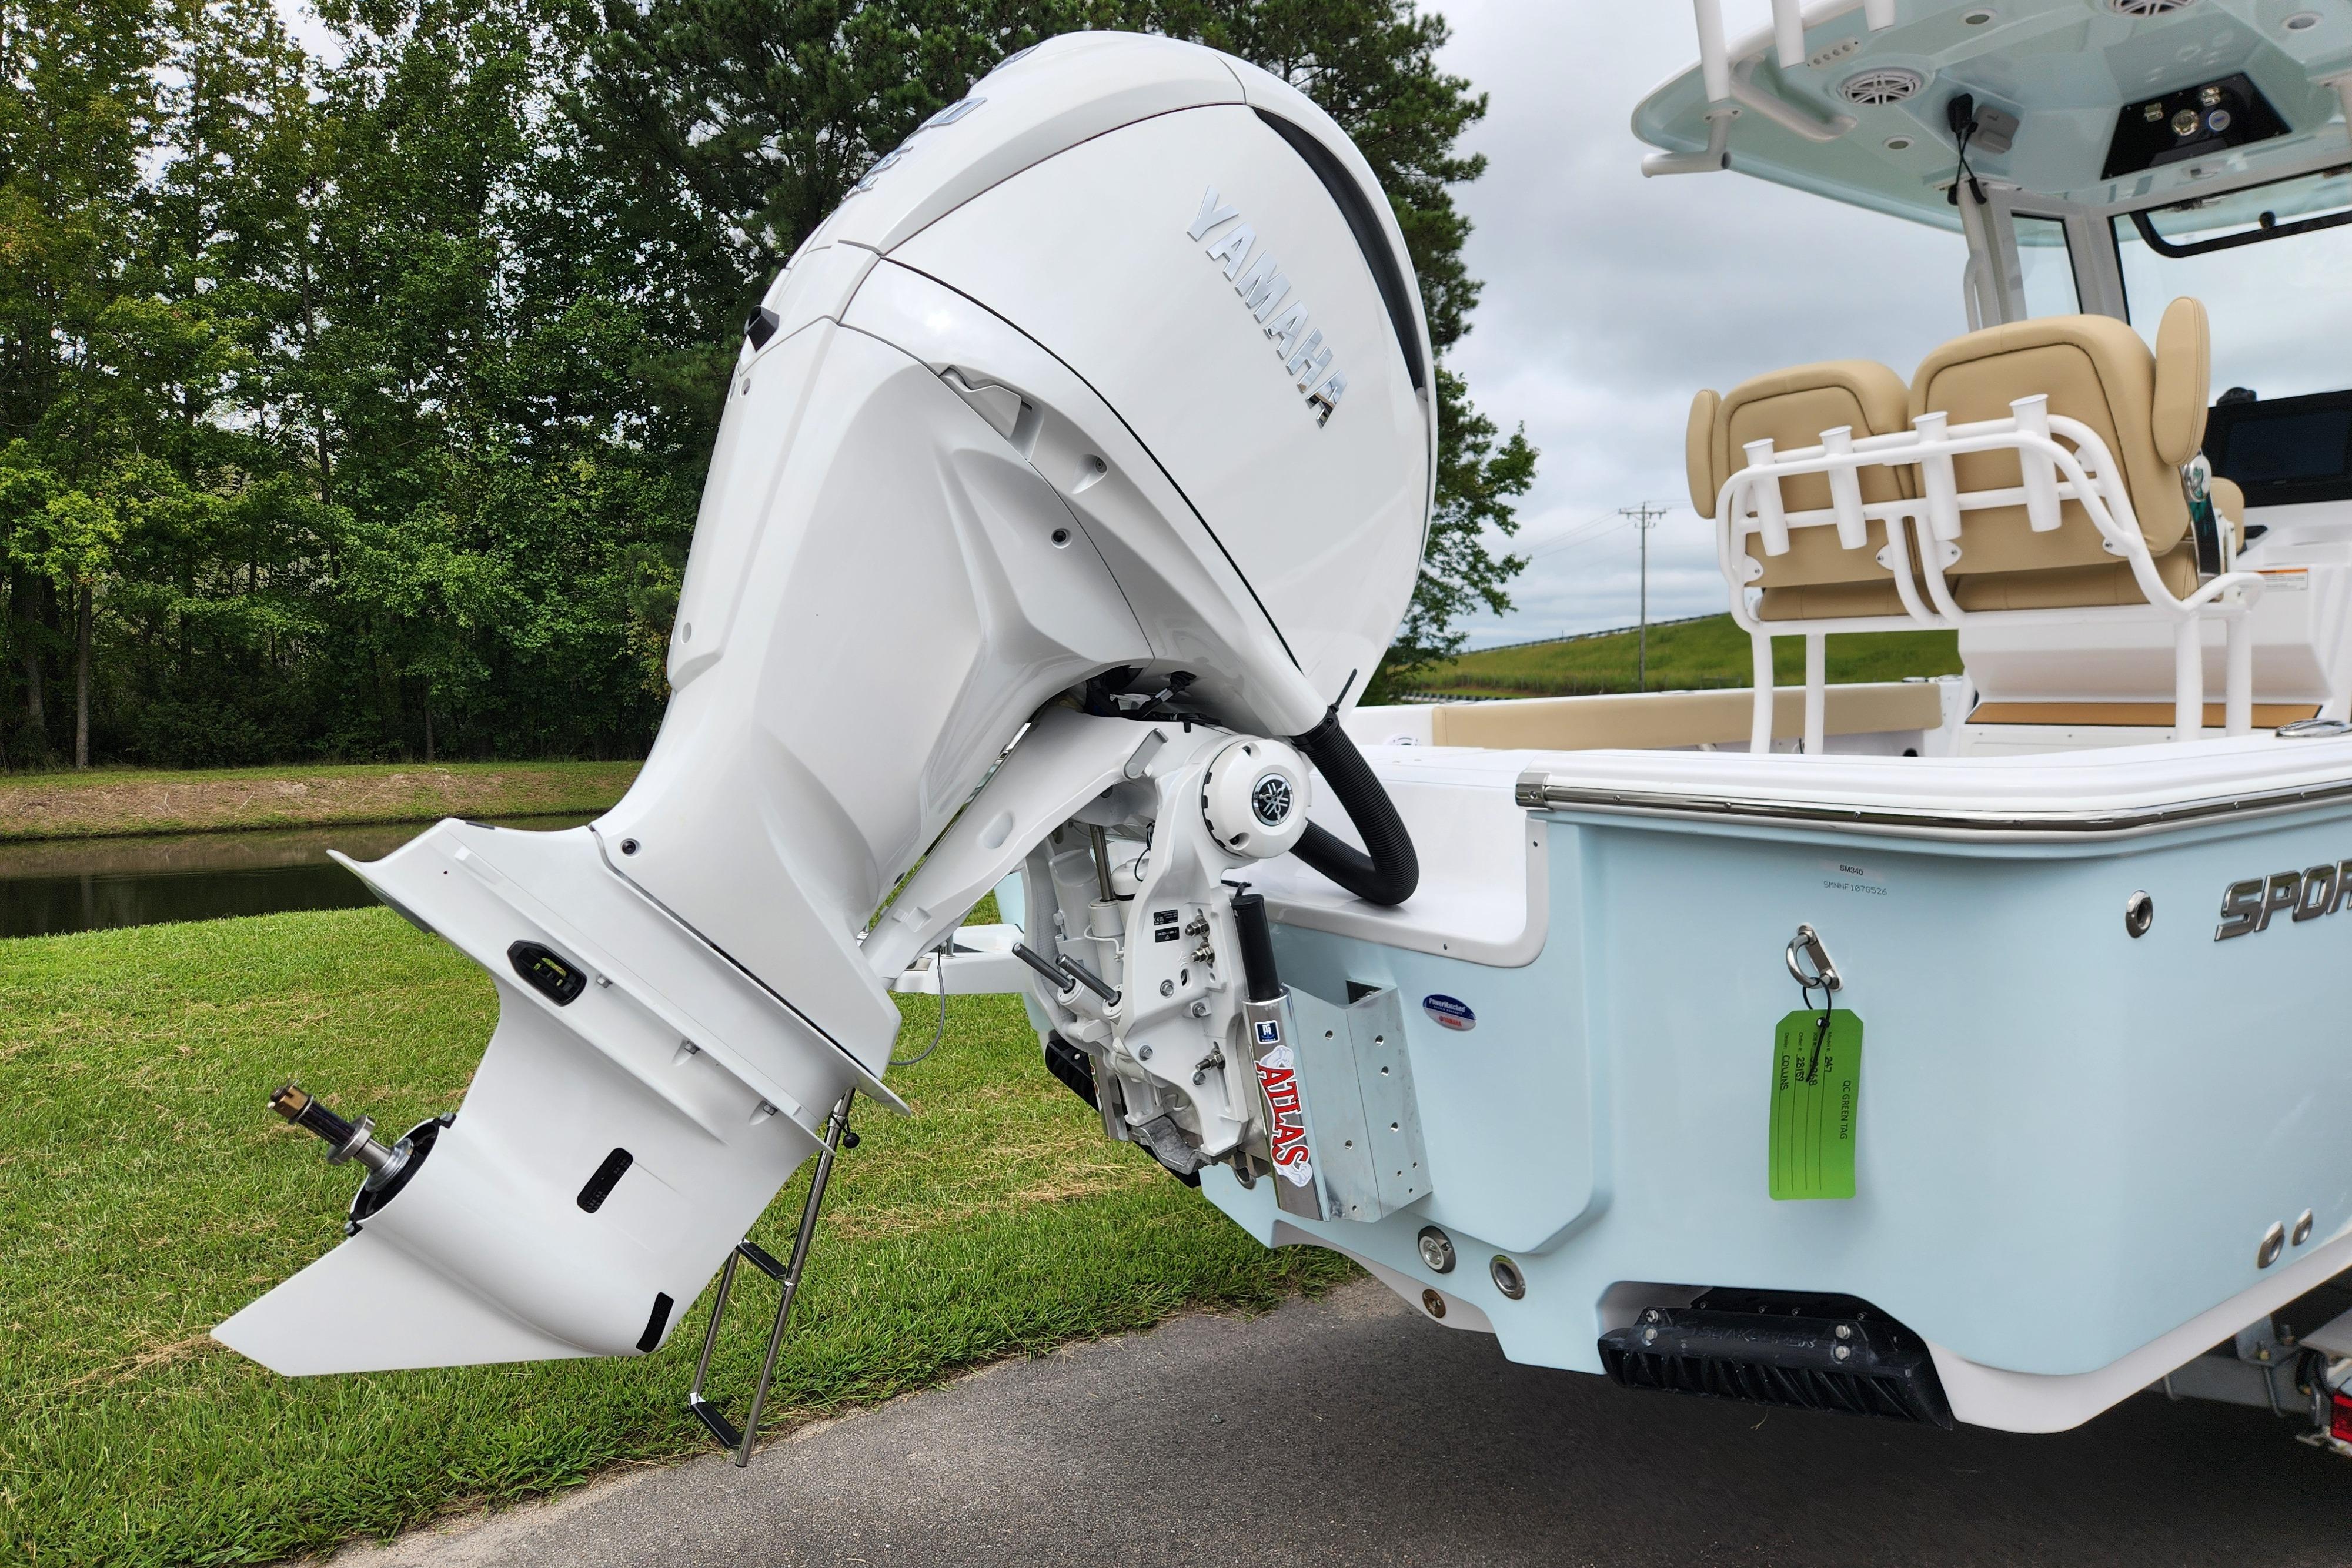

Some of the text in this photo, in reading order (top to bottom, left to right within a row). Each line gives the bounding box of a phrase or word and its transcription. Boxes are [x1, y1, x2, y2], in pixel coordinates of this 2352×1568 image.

[1187, 185, 1348, 429] YAMAHA
[1839, 864, 1863, 875] SM340
[1429, 997, 1466, 1012] PowerMatched
[1780, 1054, 1790, 1091] COLLINS
[1795, 1057, 1805, 1082] 28159
[1825, 1056, 1833, 1073] 247
[1254, 1061, 1310, 1166] ATLAS
[1839, 1080, 1851, 1140] QC GREEN TAG
